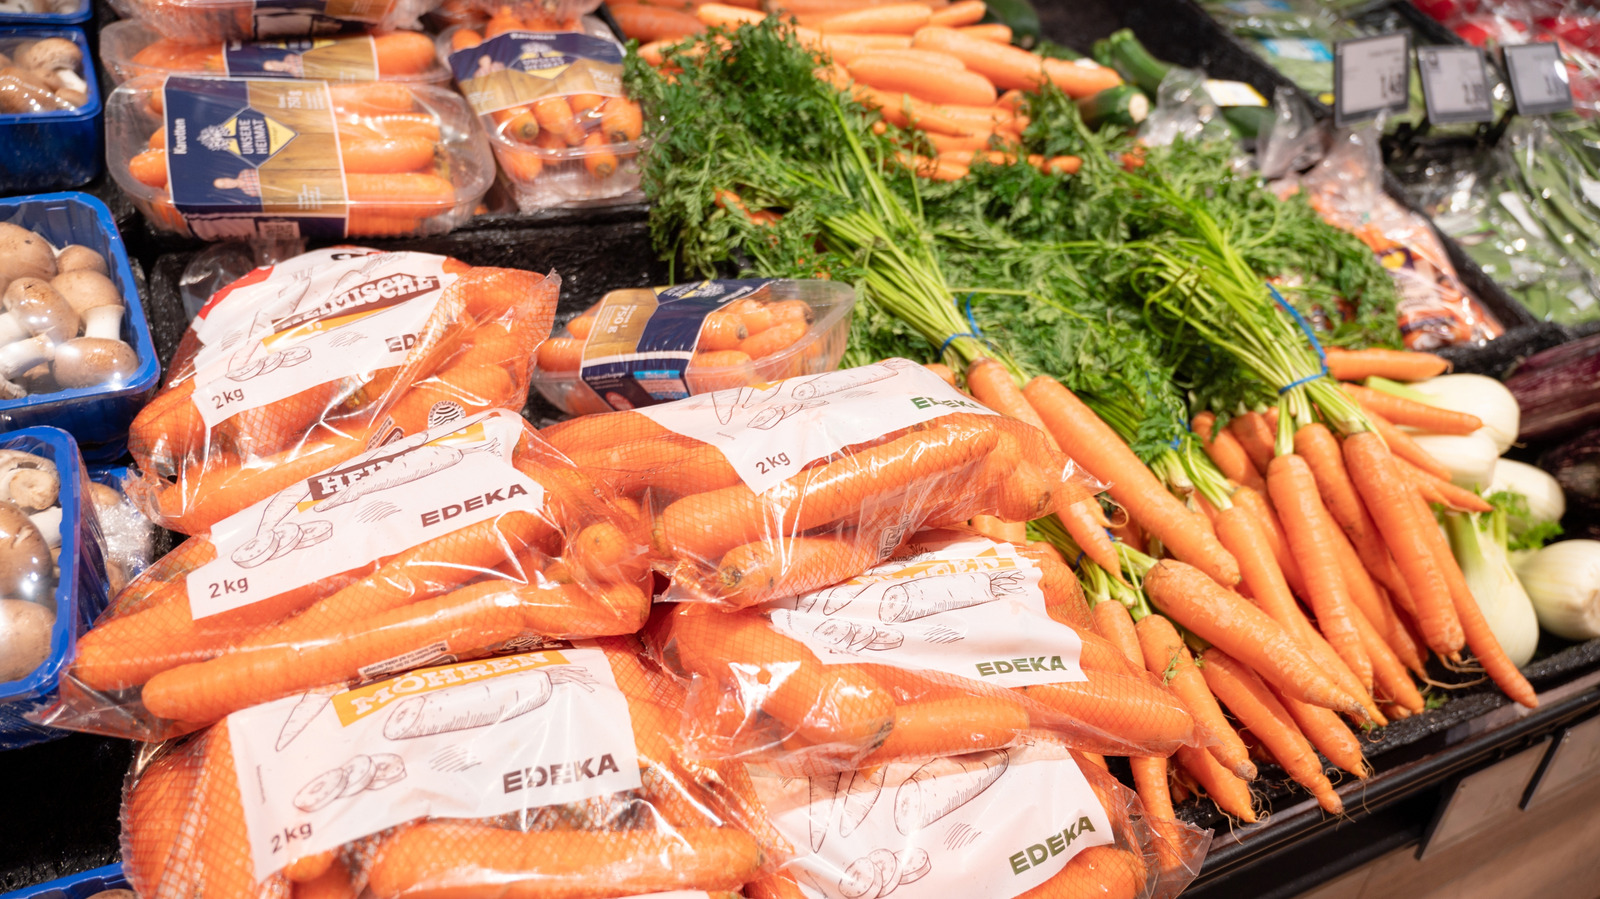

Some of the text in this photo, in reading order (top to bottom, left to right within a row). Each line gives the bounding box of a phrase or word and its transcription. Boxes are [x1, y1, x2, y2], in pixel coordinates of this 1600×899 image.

[173, 118, 187, 154] Karotten
[237, 119, 255, 155] UNSERE
[251, 119, 269, 155] HEIMAT
[421, 484, 528, 528] EDEKA
[351, 653, 549, 715] MÖHREN
[975, 655, 1068, 677] EDEKA
[502, 753, 620, 794] EDEKA
[1008, 816, 1096, 876] EDEKA
